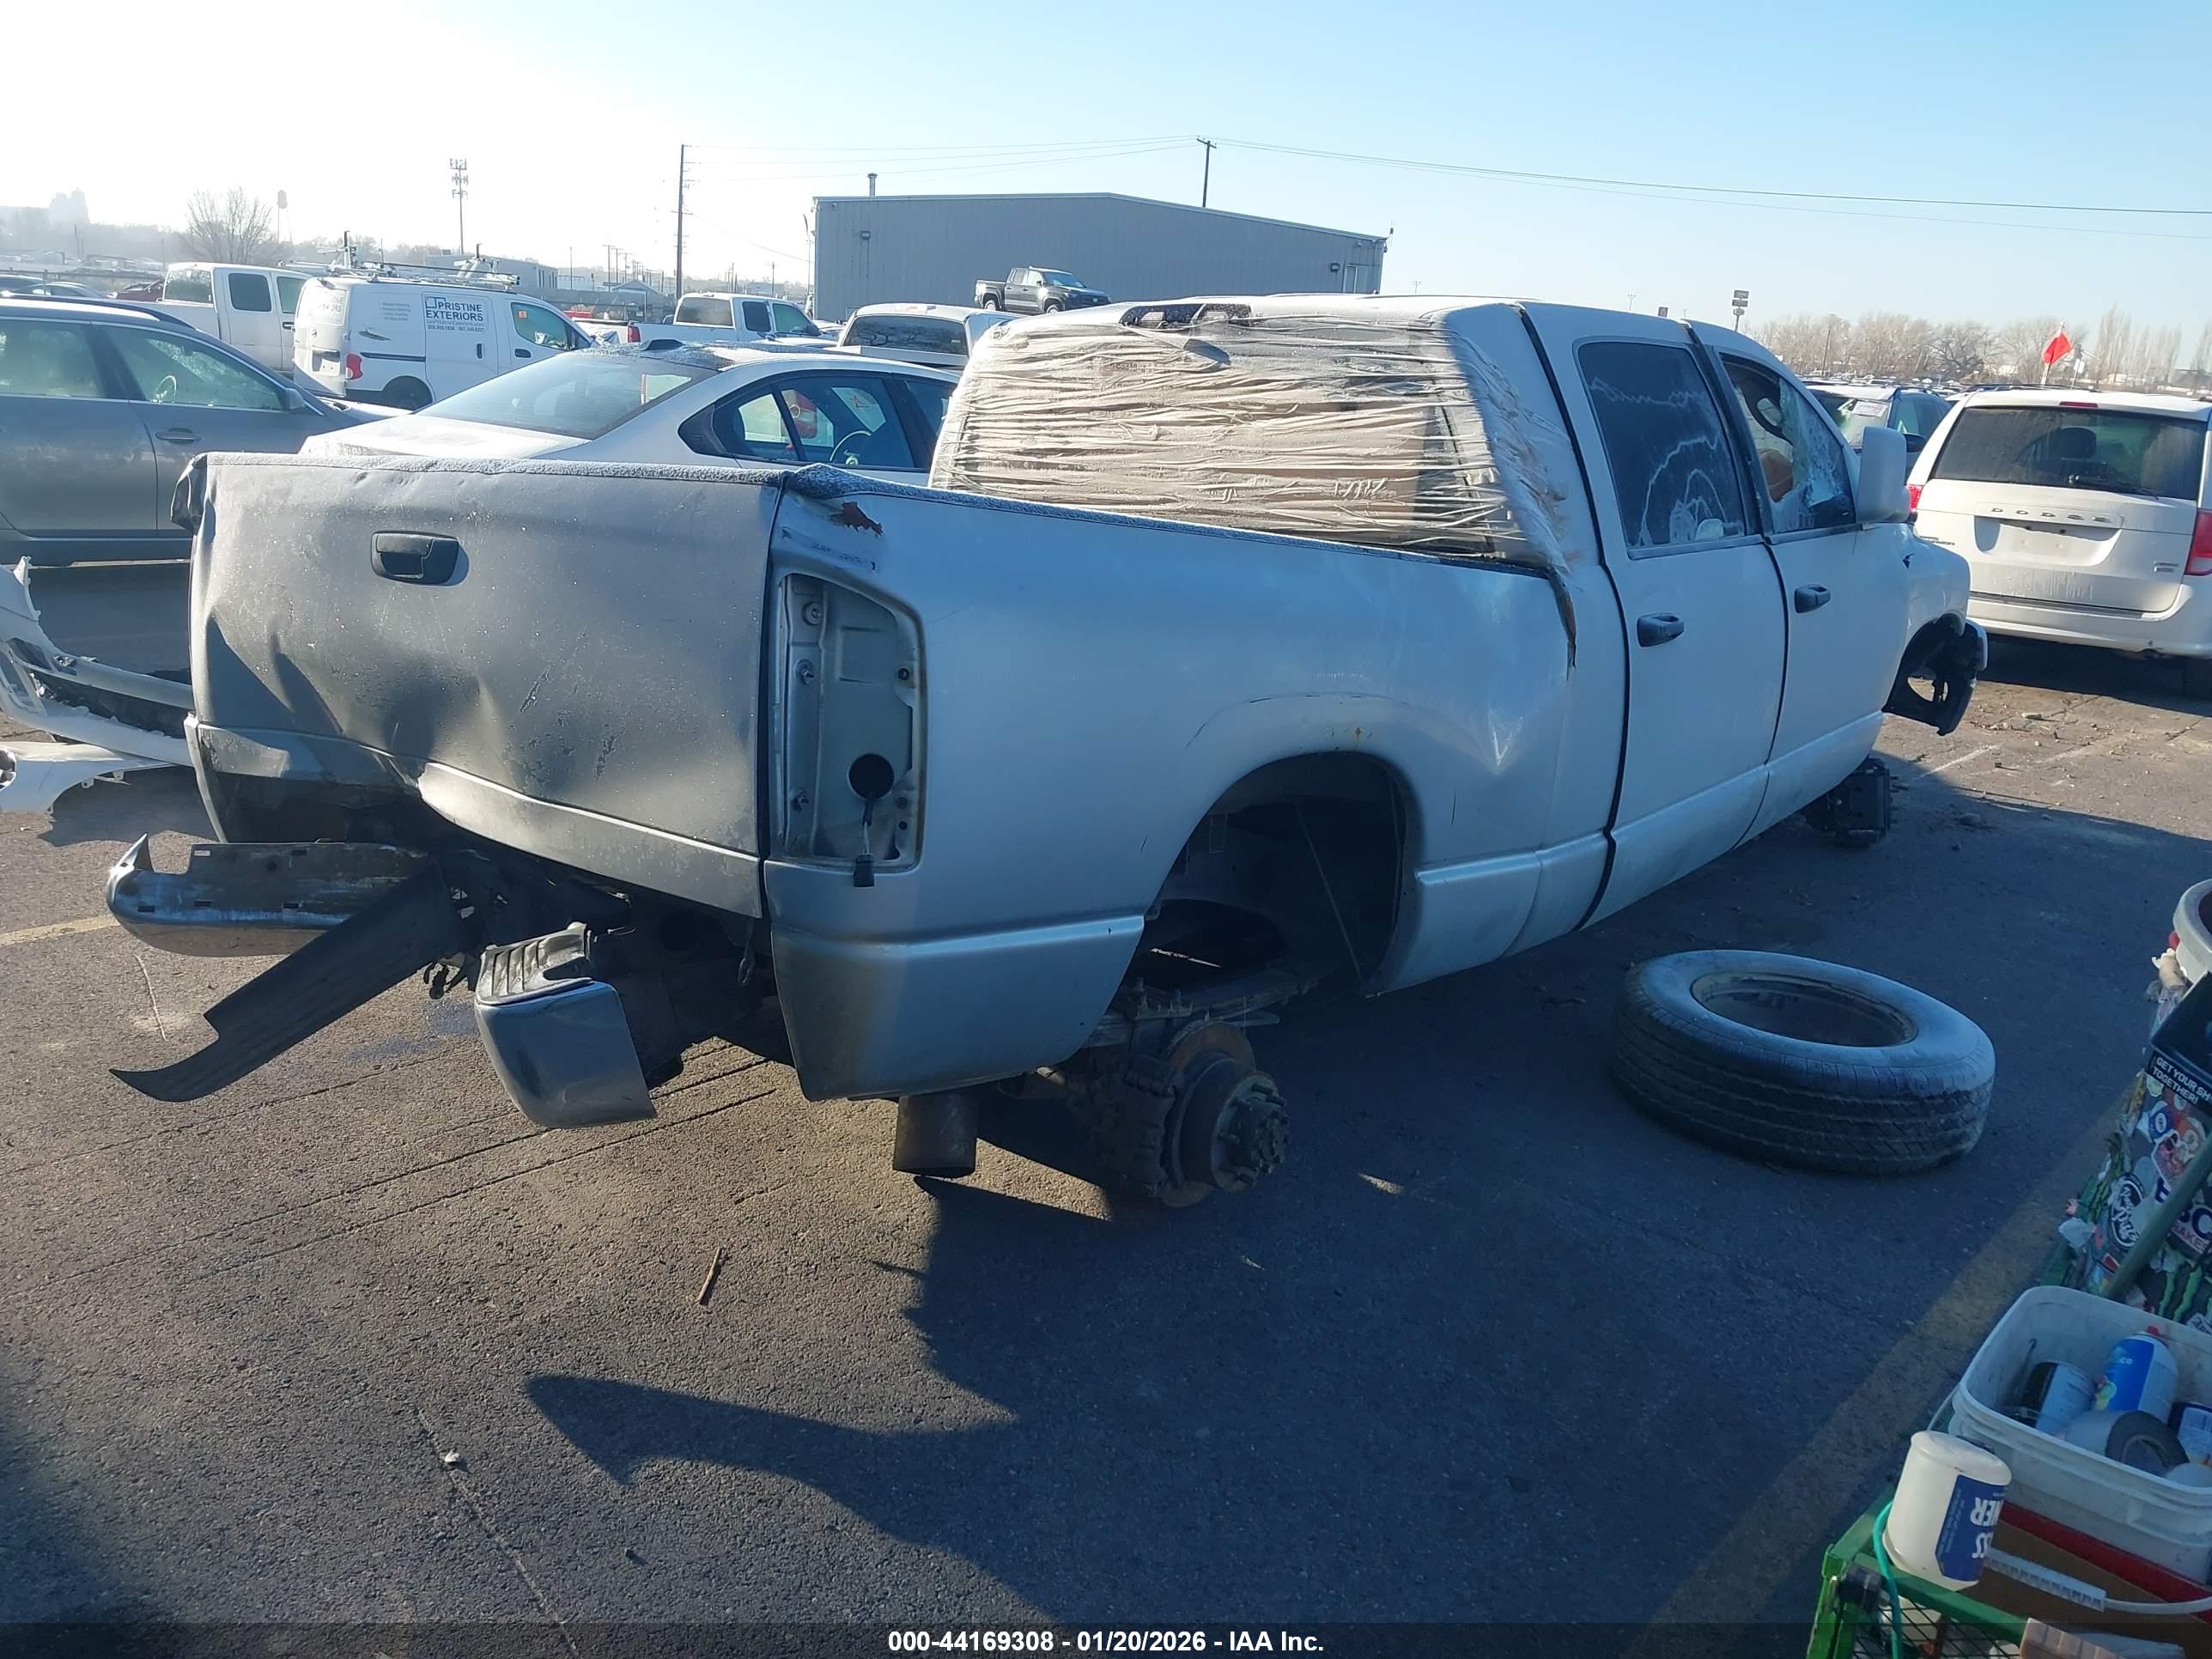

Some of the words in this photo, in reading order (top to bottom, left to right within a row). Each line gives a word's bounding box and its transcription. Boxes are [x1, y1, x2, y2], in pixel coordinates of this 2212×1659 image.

[438, 301, 483, 313] PRISTINE
[426, 310, 483, 321] EXTERIORS
[1991, 507, 2112, 523] DODGE
[2156, 1057, 2175, 1073] GET
[2173, 1068, 2198, 1091] YOUR
